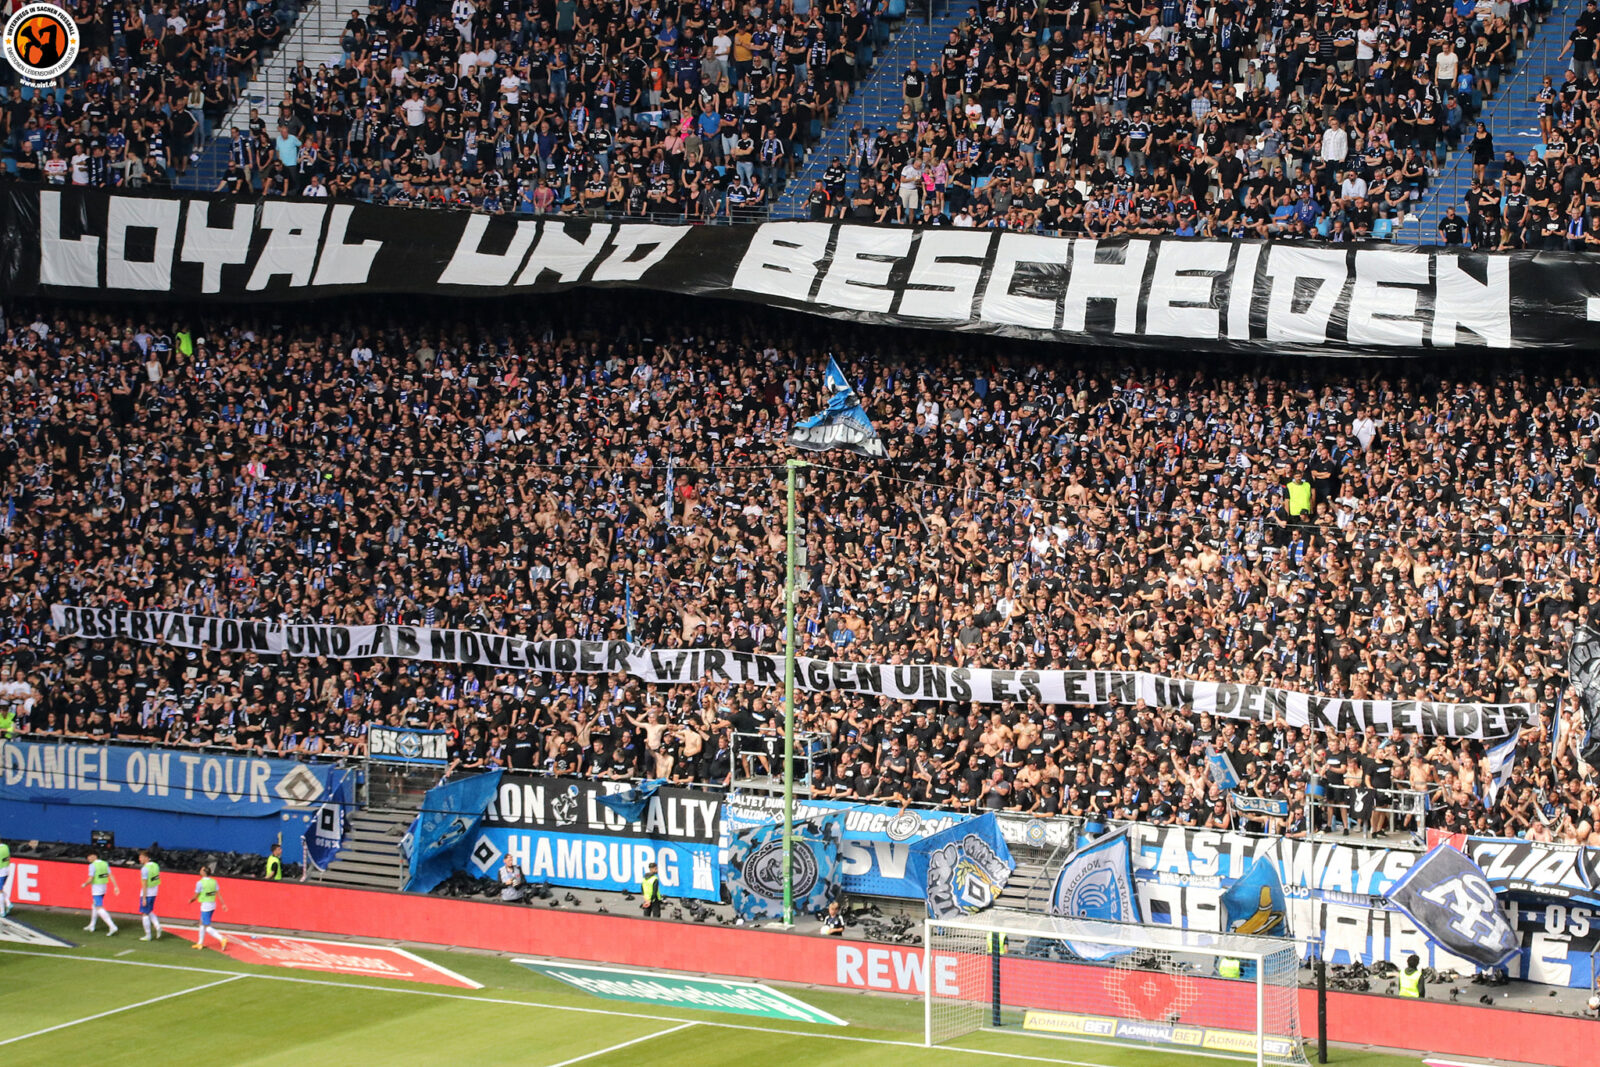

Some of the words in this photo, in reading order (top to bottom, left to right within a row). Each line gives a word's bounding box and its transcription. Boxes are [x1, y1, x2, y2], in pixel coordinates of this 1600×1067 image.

[40, 190, 382, 293] LOYAL
[437, 214, 692, 286] UND
[732, 222, 1511, 348] BESCHEIDEN
[286, 627, 350, 656] UND
[651, 648, 731, 682] WIR
[732, 652, 883, 692] TRAGEN
[895, 664, 972, 702] UNS
[991, 670, 1041, 702] ES
[1063, 671, 1141, 702] EIN
[1154, 678, 1195, 710] IN
[1215, 682, 1288, 721] DEN
[5, 744, 120, 792] DANIEL
[126, 751, 171, 797] ON
[180, 755, 271, 804] TOUR
[508, 834, 680, 888] HAMBURG
[836, 945, 959, 996] REWE
[1029, 1015, 1082, 1031] ADMIRAL
[1085, 1020, 1112, 1034] BET
[1117, 1024, 1171, 1041] ADMIRAL
[1174, 1030, 1198, 1042] BET
[1263, 1040, 1290, 1053] BET
